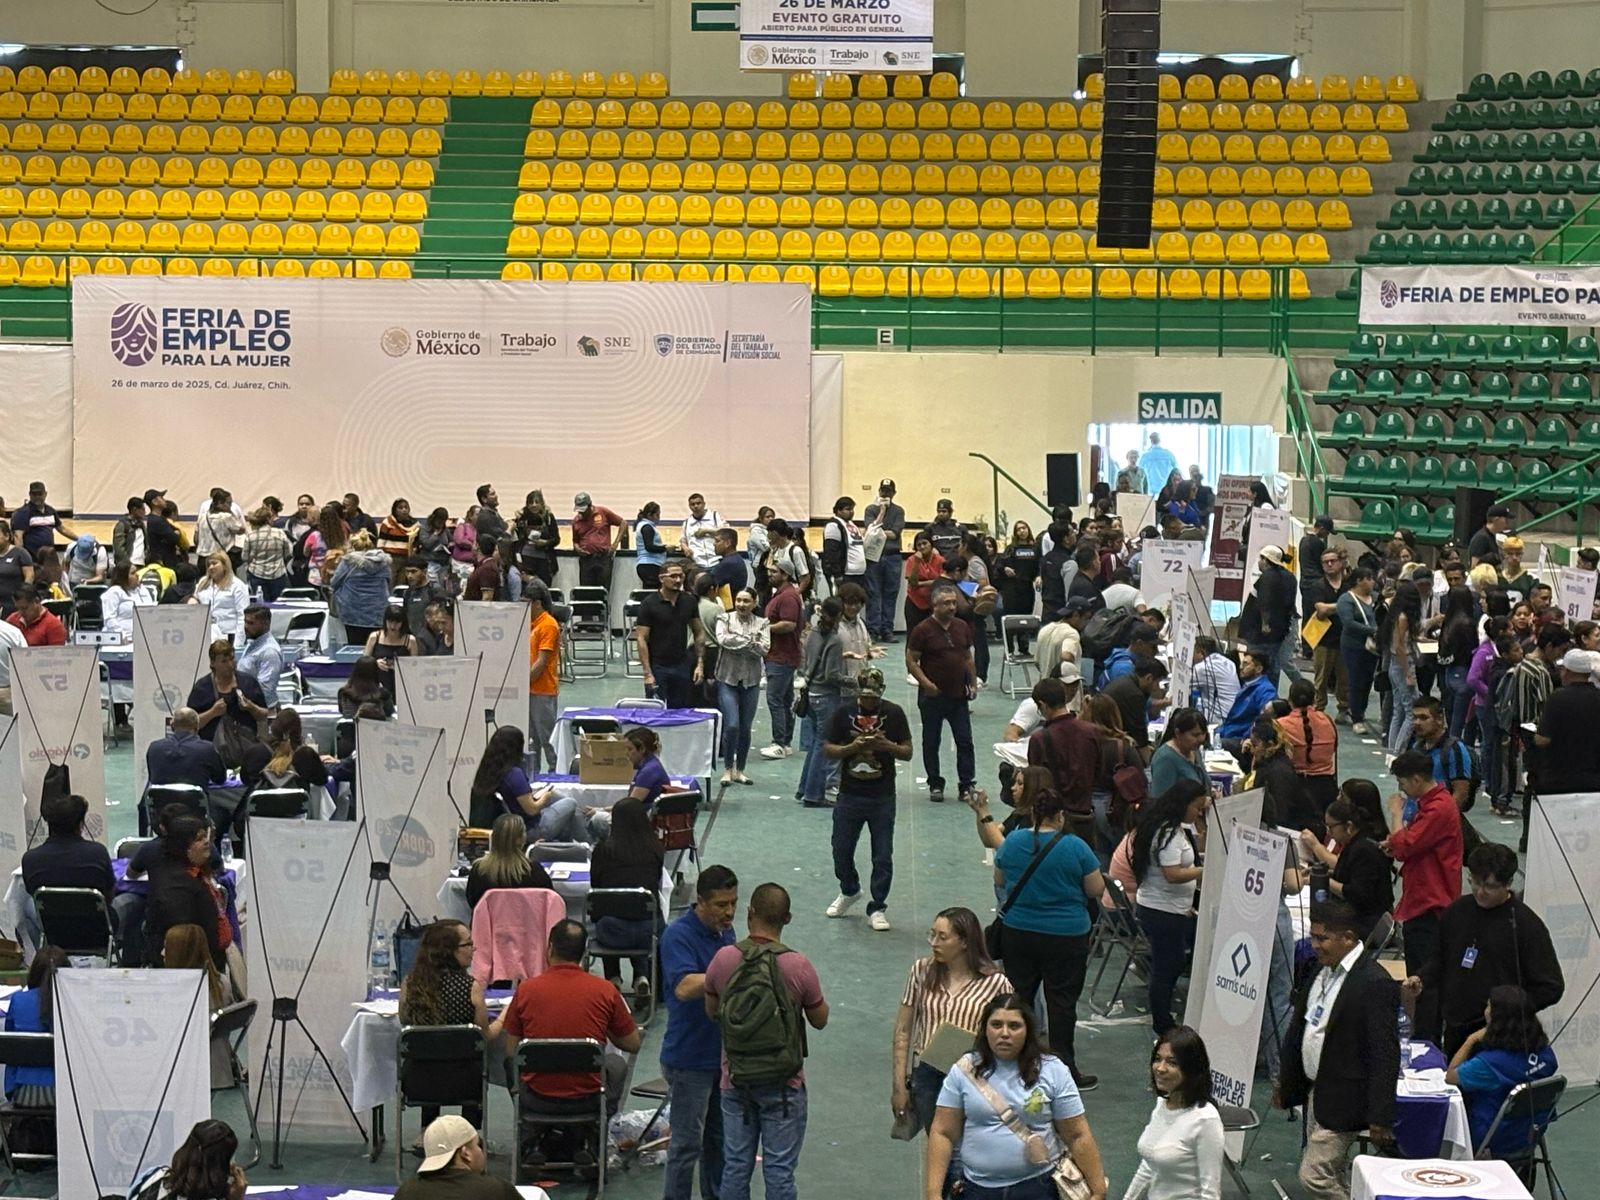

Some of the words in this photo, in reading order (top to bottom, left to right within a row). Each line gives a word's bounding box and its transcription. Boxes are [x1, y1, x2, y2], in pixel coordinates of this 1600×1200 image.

[779, 0, 798, 8] 26
[804, 0, 825, 9] DE
[831, 0, 890, 9] MARZO
[772, 13, 828, 23] EVENTO
[833, 14, 901, 24] GRATUITO
[820, 24, 853, 32] PÚBLICO
[772, 54, 816, 65] México
[830, 49, 869, 59] Trabajo
[1400, 287, 1453, 302] FERIA
[1460, 287, 1485, 303] DE
[1490, 287, 1569, 303] EMPLEO
[163, 308, 245, 328] FERIA
[254, 309, 290, 329] DE
[163, 328, 291, 352] EMPLEO
[416, 330, 466, 339] Gobierno
[469, 330, 480, 339] de
[501, 333, 557, 348] Trabajo
[731, 333, 765, 342] SECRETARÍA
[880, 330, 891, 343] E
[416, 339, 480, 355] México
[604, 336, 631, 347] SNE
[731, 342, 742, 351] DEL
[743, 343, 768, 351] TRABAJO
[162, 354, 205, 366] PARA
[210, 354, 231, 366] LA
[237, 355, 290, 367] MUJER
[730, 350, 760, 359] PREVISIÓN
[761, 351, 781, 360] SOCIAL
[111, 380, 123, 388] 26
[126, 379, 138, 388] de
[171, 380, 183, 388] de
[186, 380, 212, 390] 2025,
[215, 380, 230, 389] Cd.
[233, 381, 265, 390] Juárez,
[267, 381, 291, 390] Chih.
[1141, 398, 1218, 419] SALIDA
[1163, 560, 1182, 572] 72
[1568, 603, 1579, 618] 81
[1245, 868, 1265, 895] 65
[1239, 983, 1257, 1000] club
[1211, 1069, 1232, 1089] FERIA
[1235, 1080, 1246, 1095] DE
